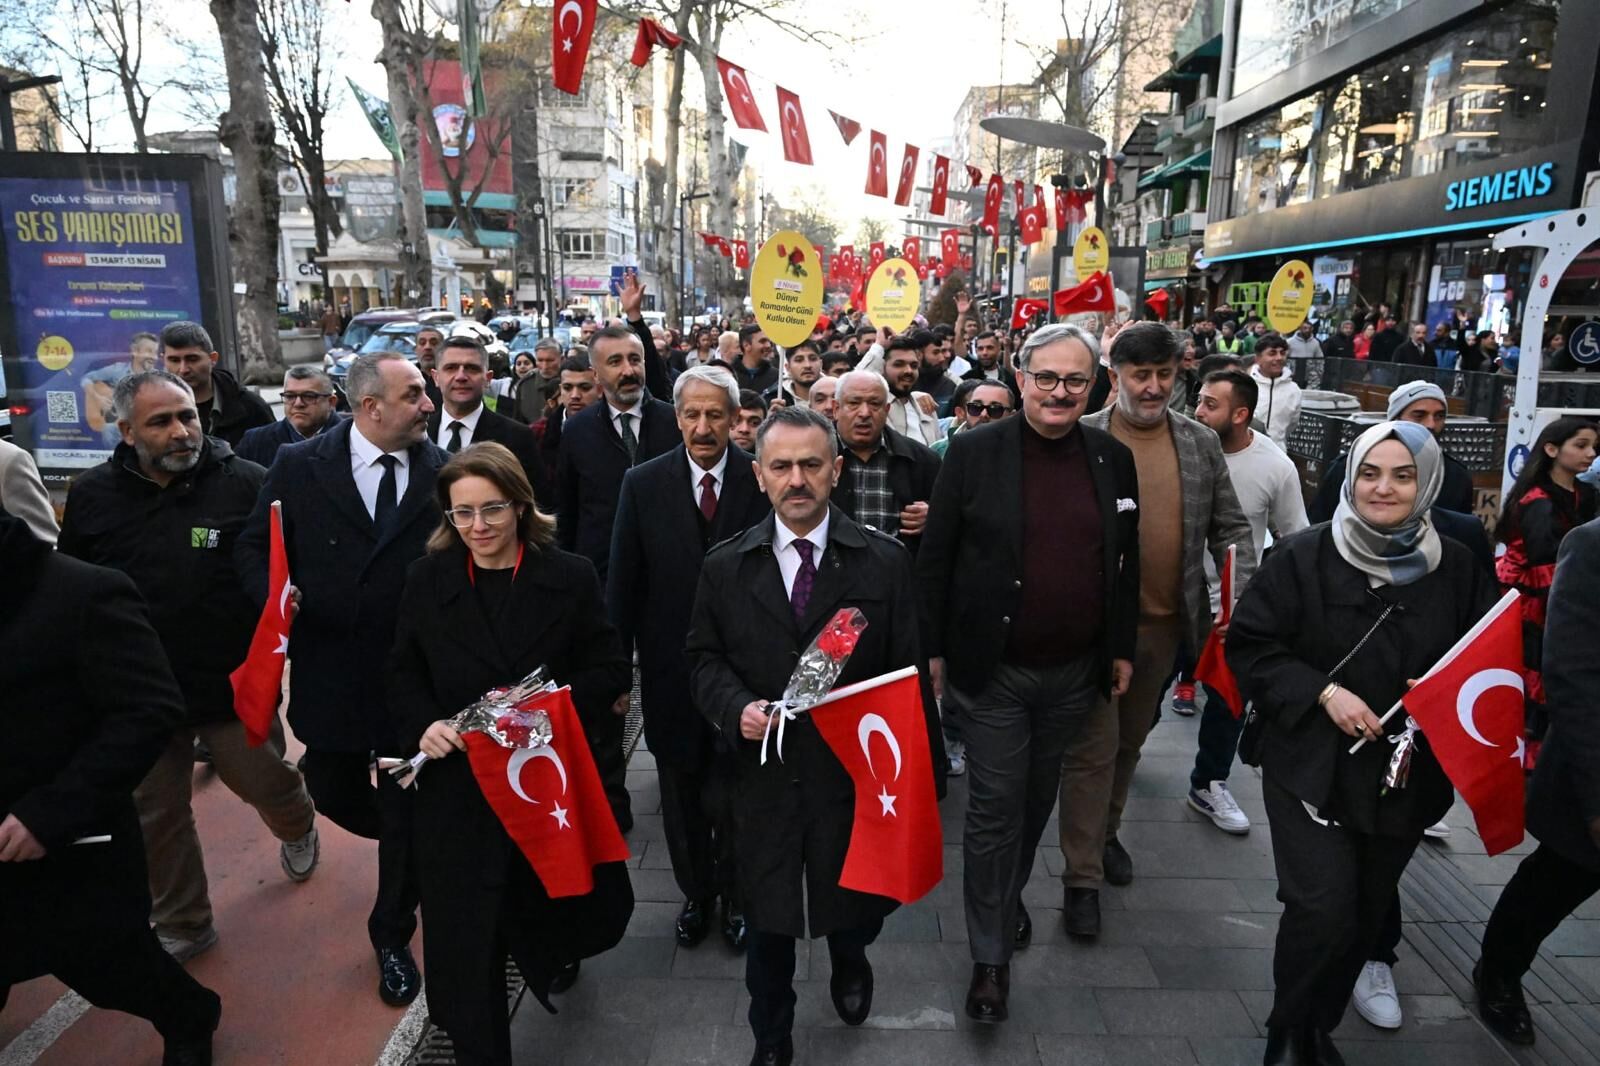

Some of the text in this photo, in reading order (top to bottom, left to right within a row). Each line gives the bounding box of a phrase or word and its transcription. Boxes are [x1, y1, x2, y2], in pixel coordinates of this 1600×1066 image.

[1445, 162, 1553, 211] SIEMENS
[31, 194, 161, 206] Çocuk ve Sanat Festivali
[15, 211, 183, 248] SES YARIŞMASI
[90, 256, 99, 264] 13
[100, 257, 136, 265] MART-13
[137, 256, 161, 265] NİSAN
[776, 292, 799, 303] Dünya
[760, 301, 814, 316] Romanlar Günü
[766, 313, 785, 323] Kutlu
[44, 345, 67, 356] 7-14
